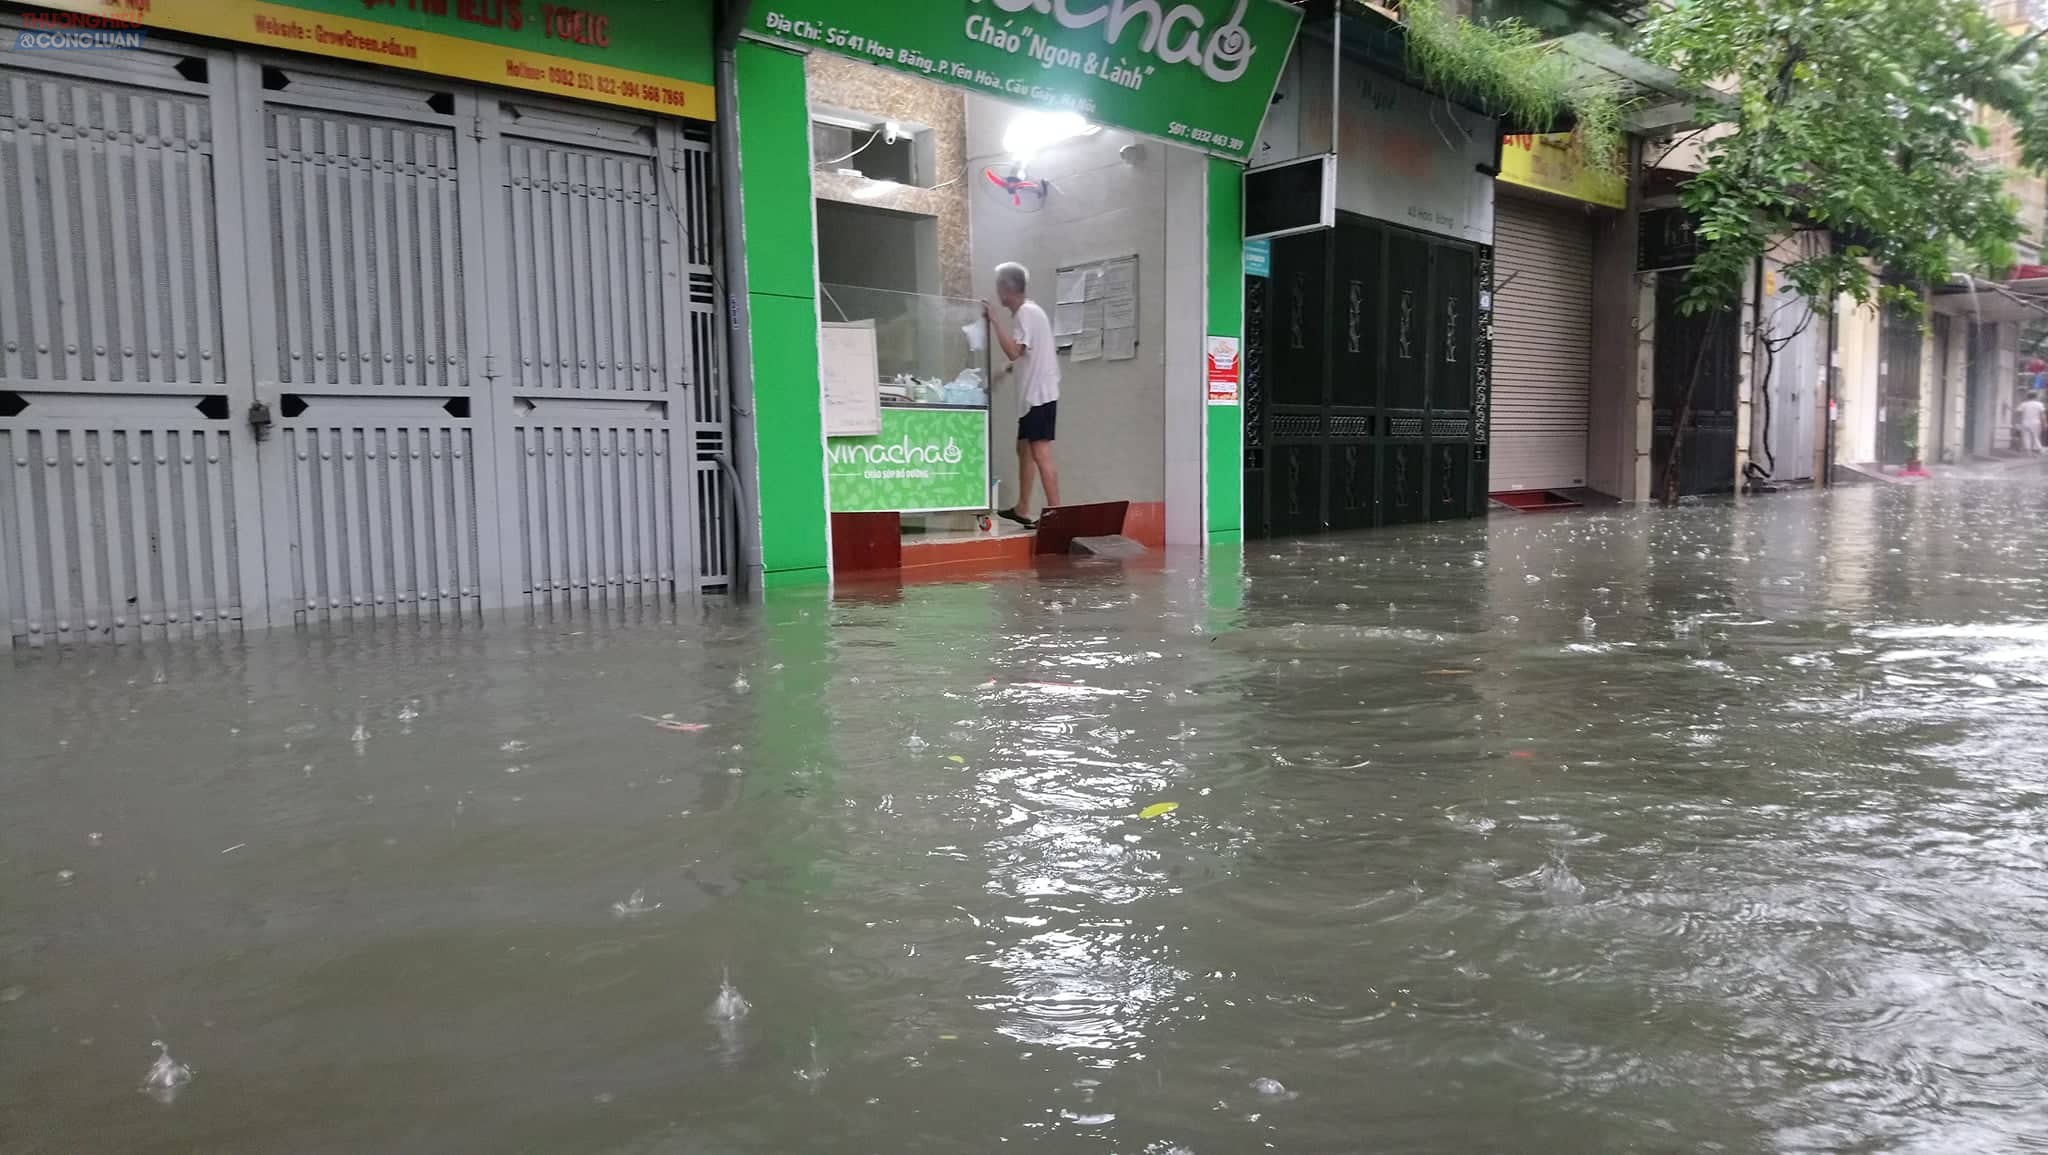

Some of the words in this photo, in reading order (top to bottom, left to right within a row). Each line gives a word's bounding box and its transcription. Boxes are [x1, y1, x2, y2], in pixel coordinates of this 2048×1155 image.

[543, 4, 610, 48] TOEIC
[766, 12, 792, 35] Địa
[826, 27, 850, 46] Số
[848, 35, 864, 51] 41
[866, 39, 895, 60] Hoa
[950, 62, 974, 81] Yên
[1005, 78, 1030, 96] Cầu
[964, 15, 1021, 54] Cháo
[1083, 52, 1099, 76] &
